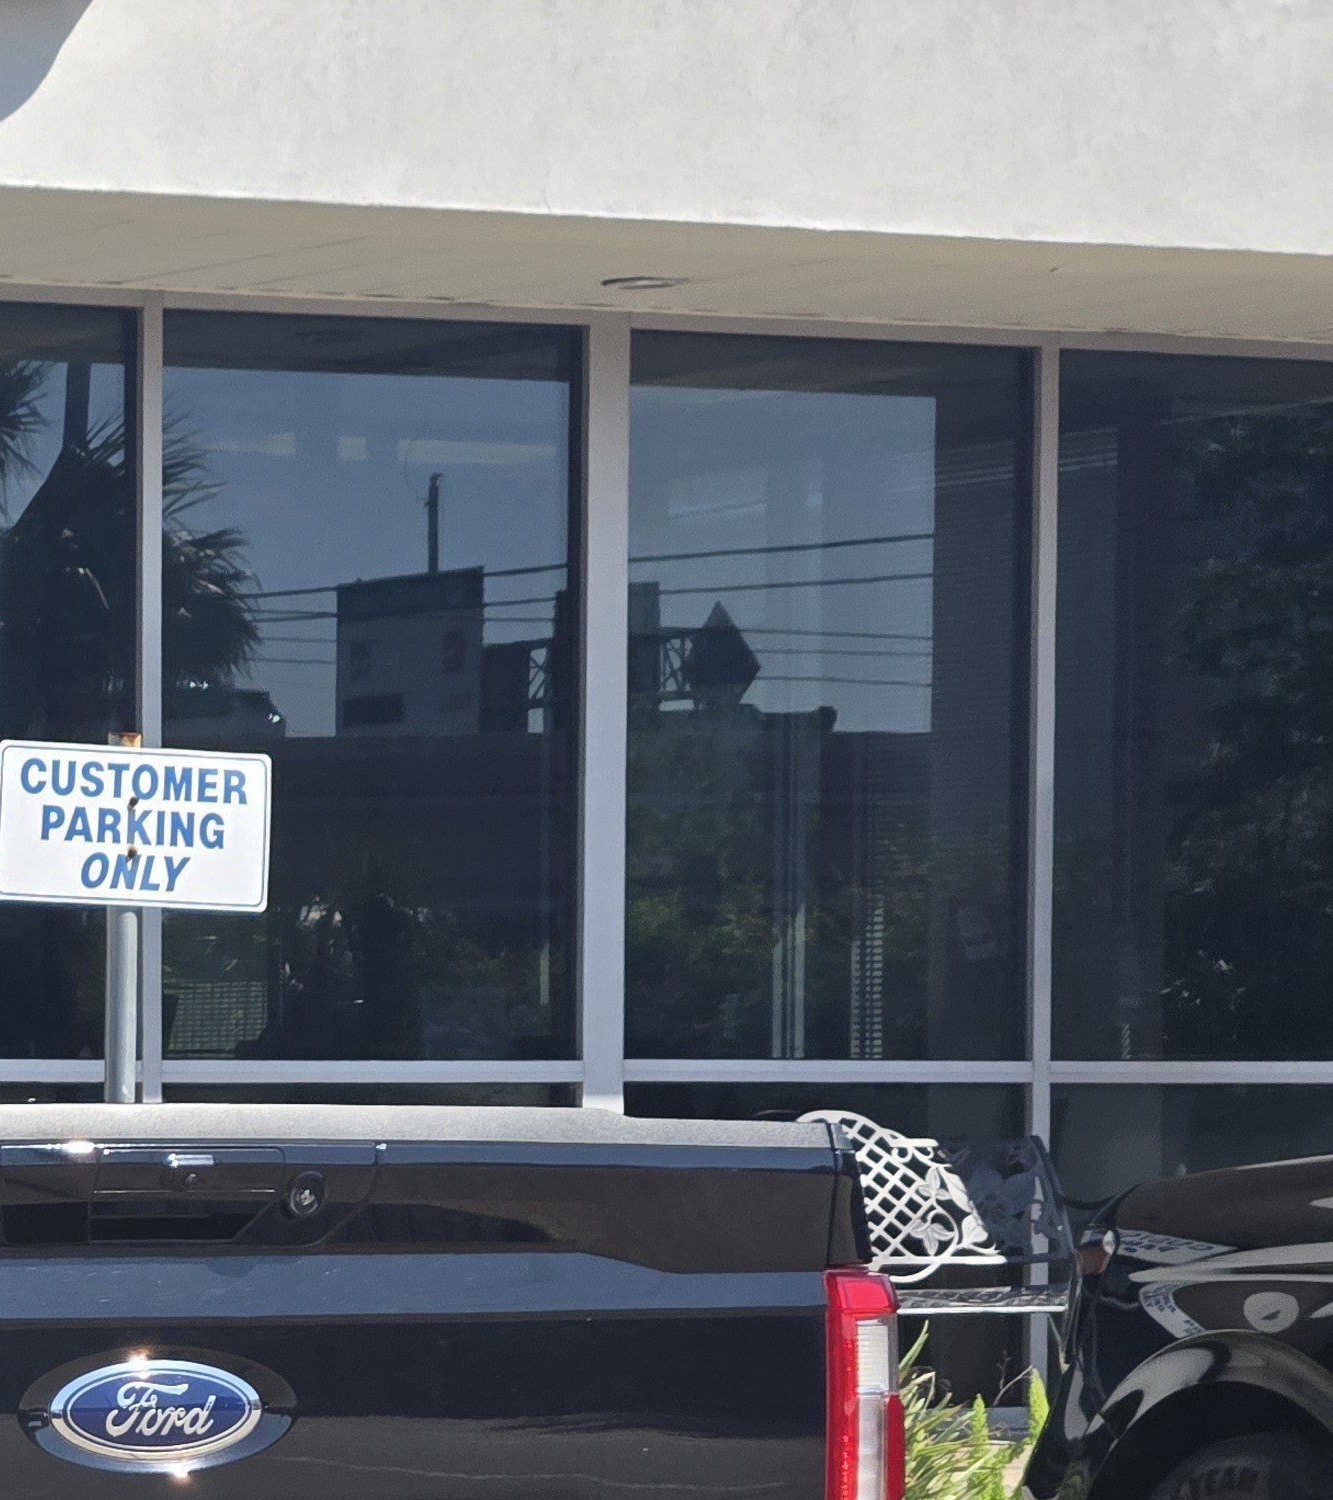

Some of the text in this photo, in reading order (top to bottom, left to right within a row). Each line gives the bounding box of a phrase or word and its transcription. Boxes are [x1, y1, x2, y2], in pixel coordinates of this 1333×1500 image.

[20, 758, 248, 805] CUSTOMER
[40, 805, 225, 849] PARKING
[80, 852, 191, 892] ONLY
[105, 1381, 216, 1437] Ford
